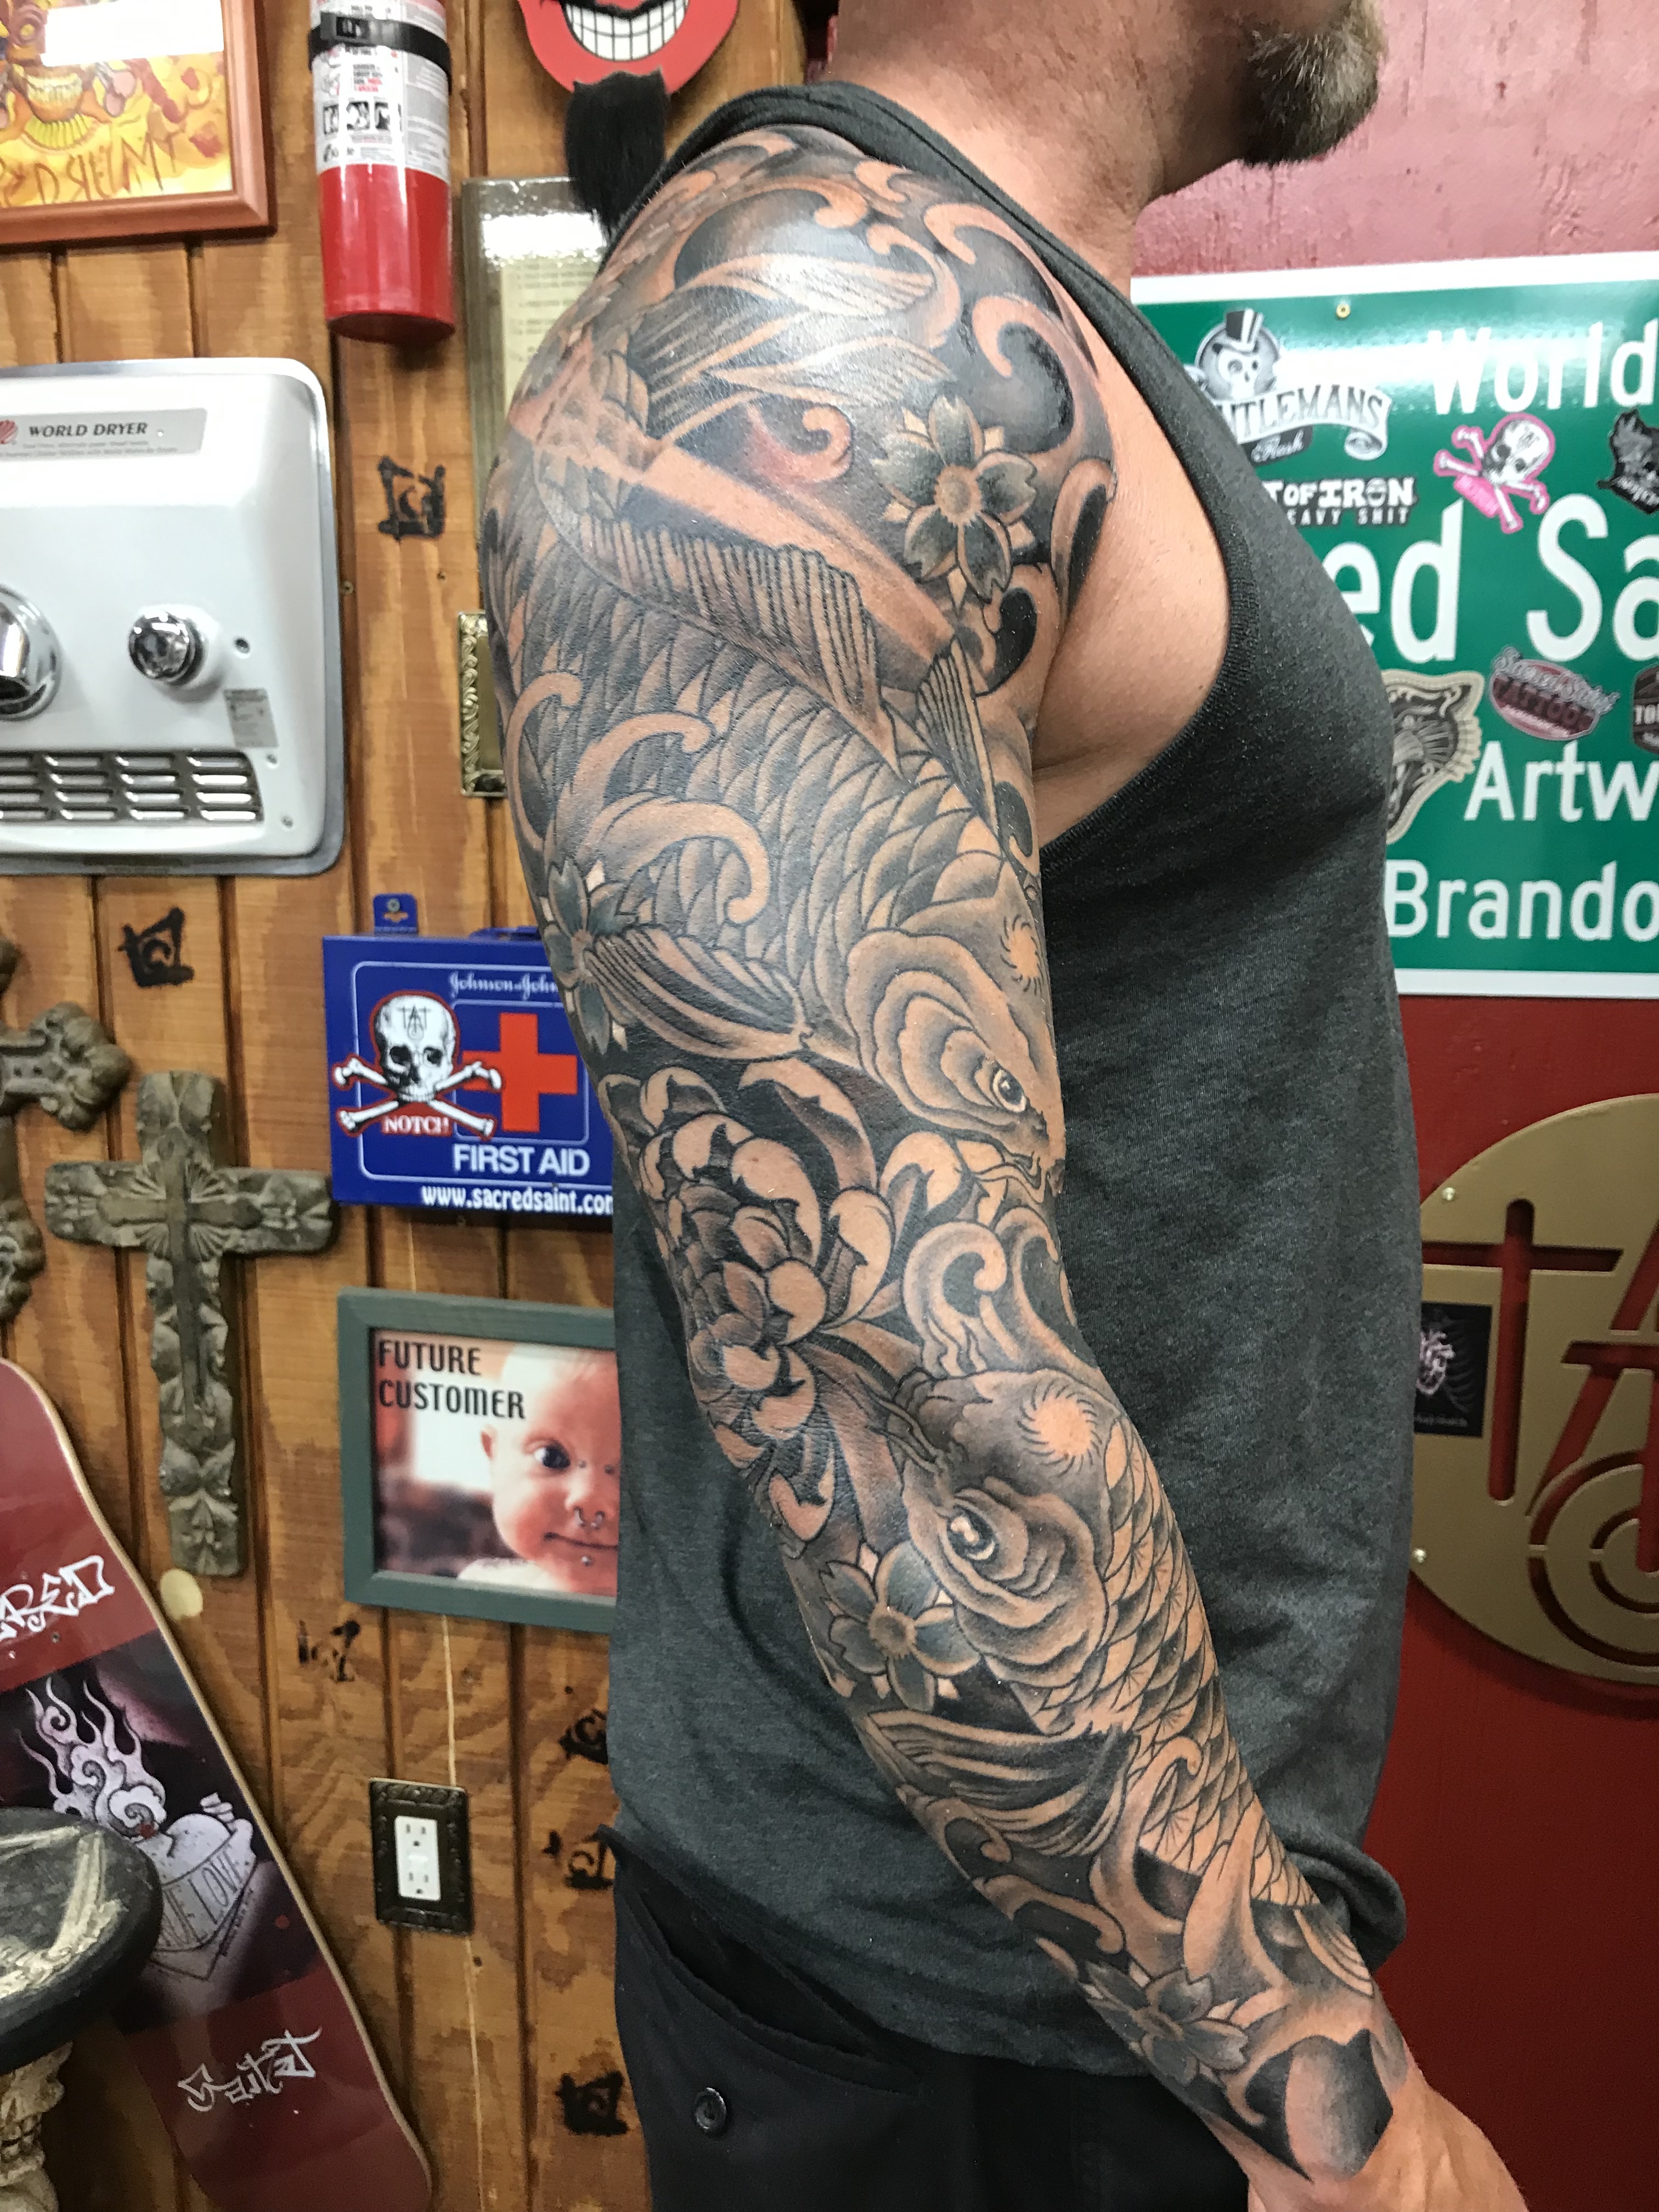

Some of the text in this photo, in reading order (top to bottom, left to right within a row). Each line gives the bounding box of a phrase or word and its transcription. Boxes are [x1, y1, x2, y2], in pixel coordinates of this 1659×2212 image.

[1427, 318, 1658, 415] World
[29, 422, 148, 438] WORLD DRYER
[1318, 476, 1415, 508] IRON
[385, 1115, 449, 1135] NOTCH
[453, 1143, 591, 1177] FIRST AID
[378, 1338, 482, 1376] FUTURE
[379, 1379, 526, 1420] CUSTOMER
